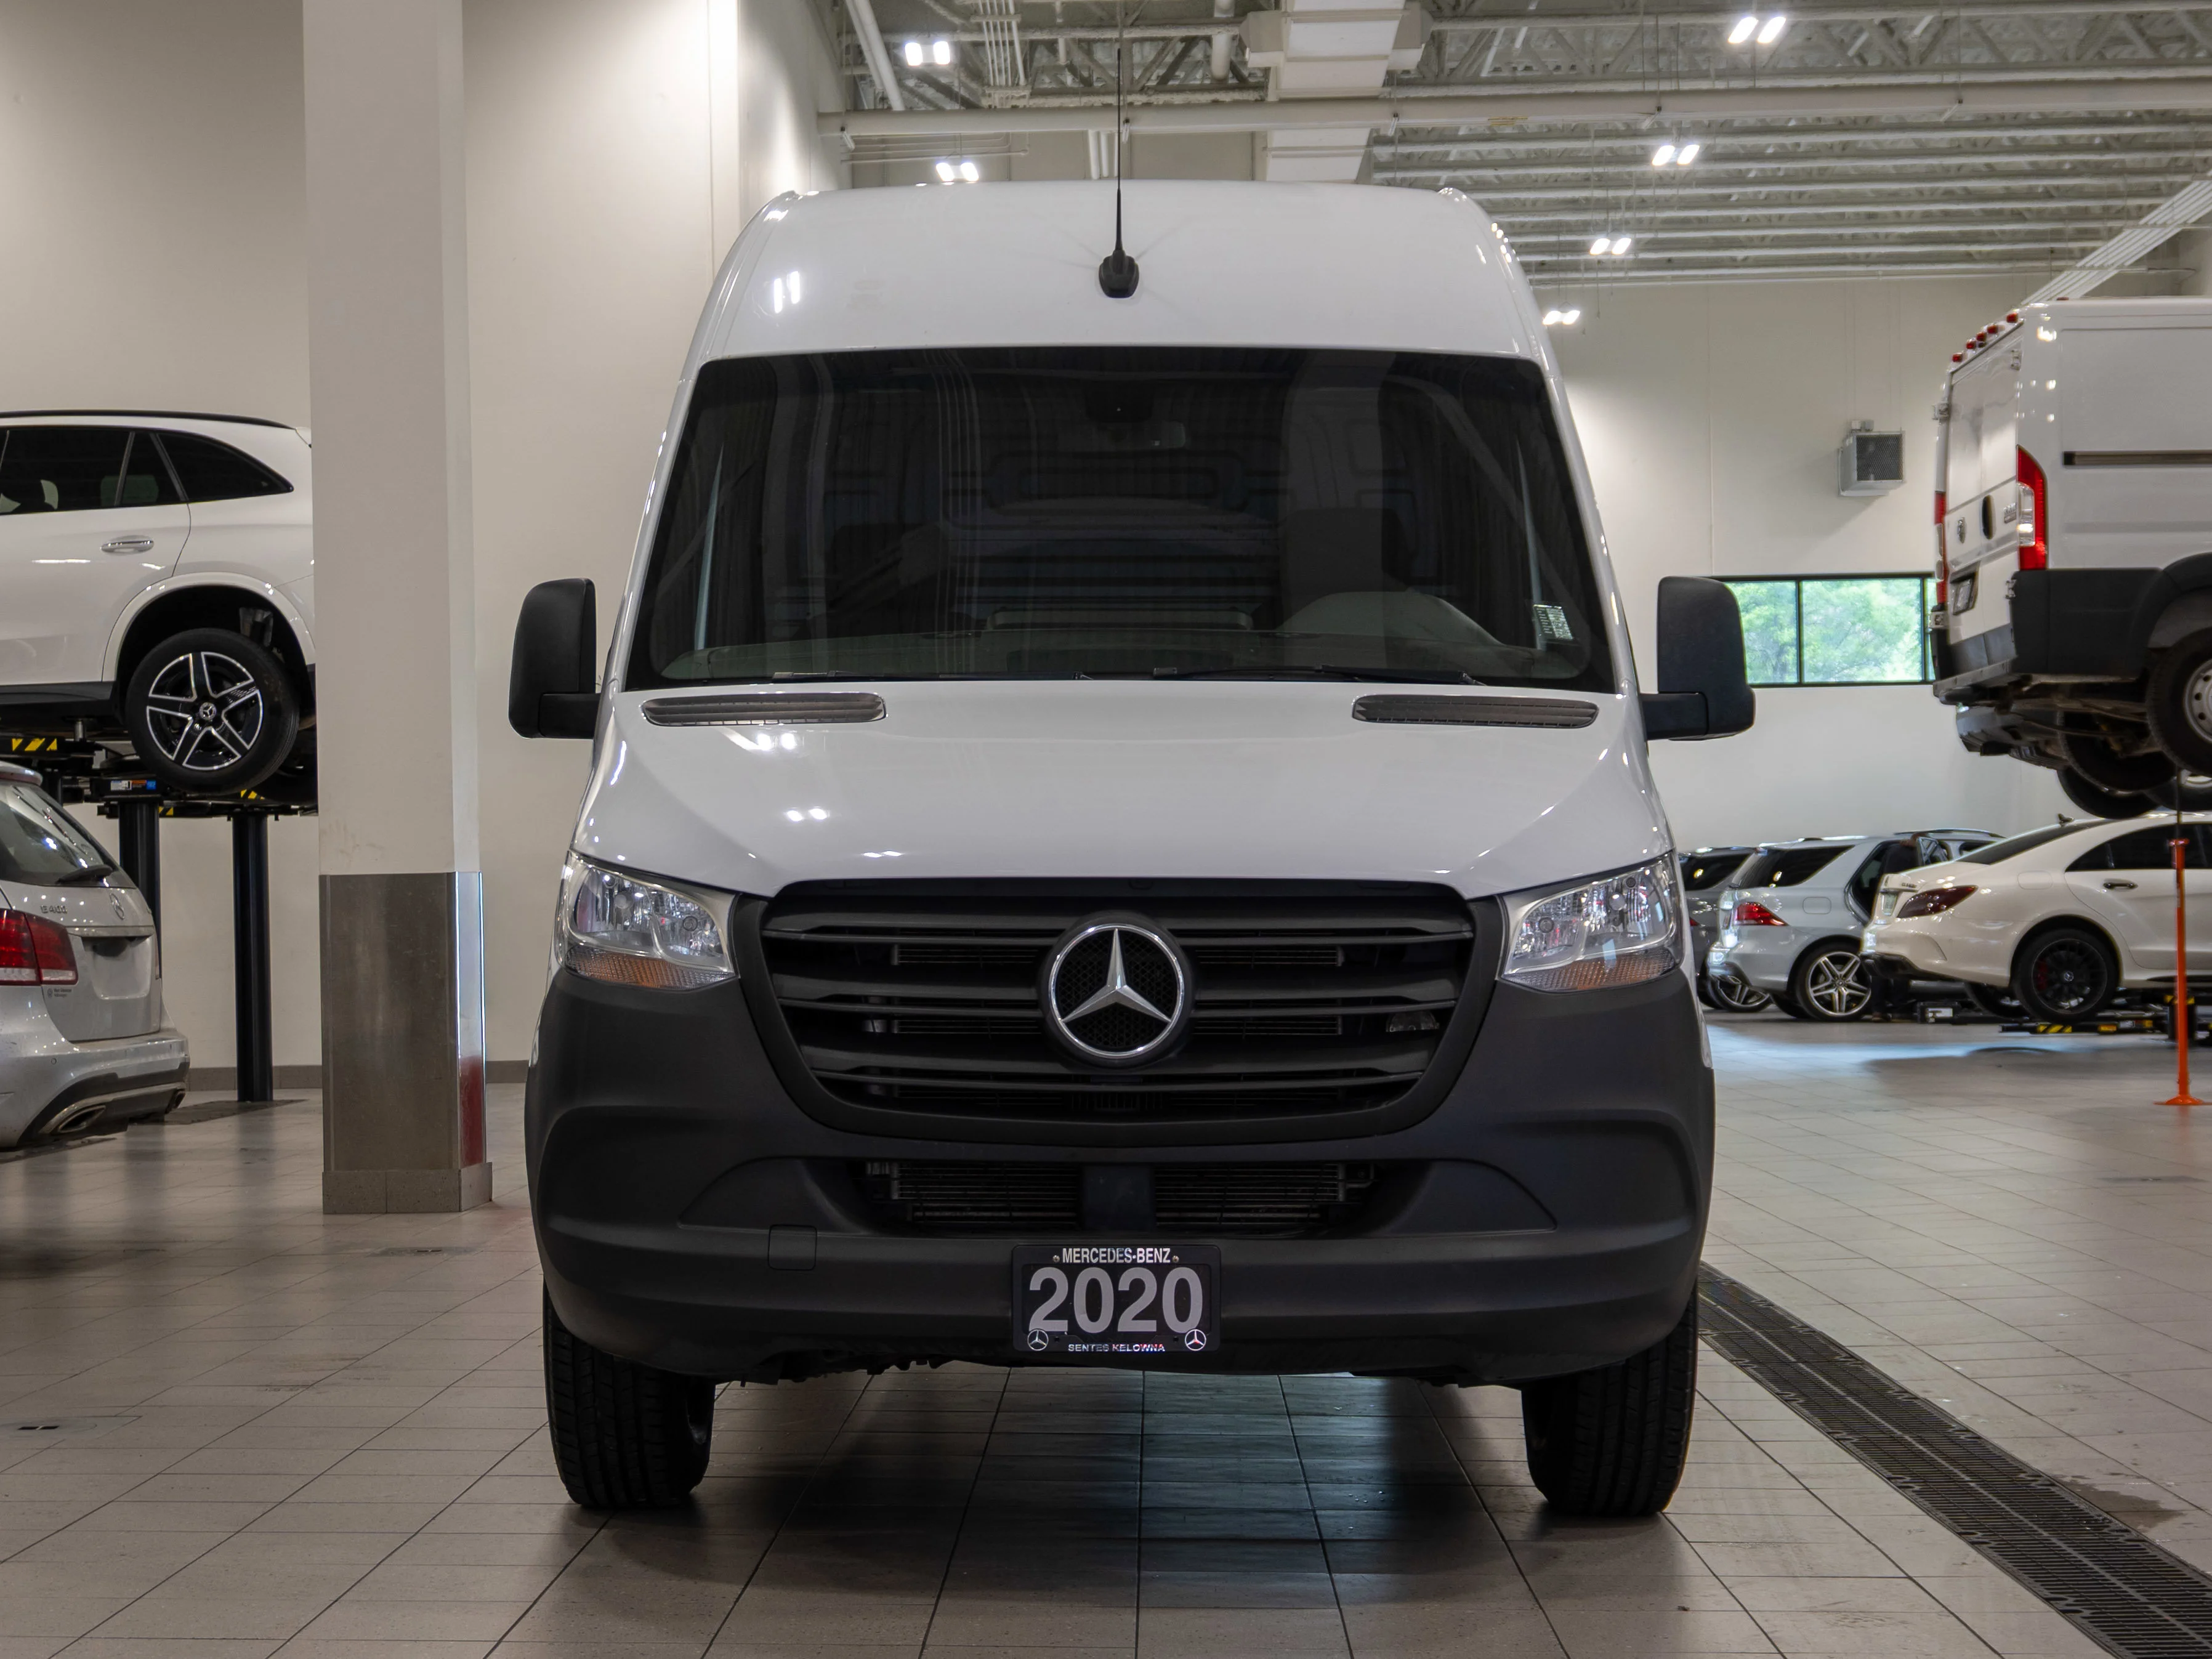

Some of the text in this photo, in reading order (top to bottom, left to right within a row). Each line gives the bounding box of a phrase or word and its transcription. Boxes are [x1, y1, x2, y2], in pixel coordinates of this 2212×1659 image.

[1062, 1248, 1171, 1263] MERCEDES-BENZ
[1029, 1267, 1203, 1333] 2020
[1068, 1344, 1165, 1352] SENTES KELOWNA
